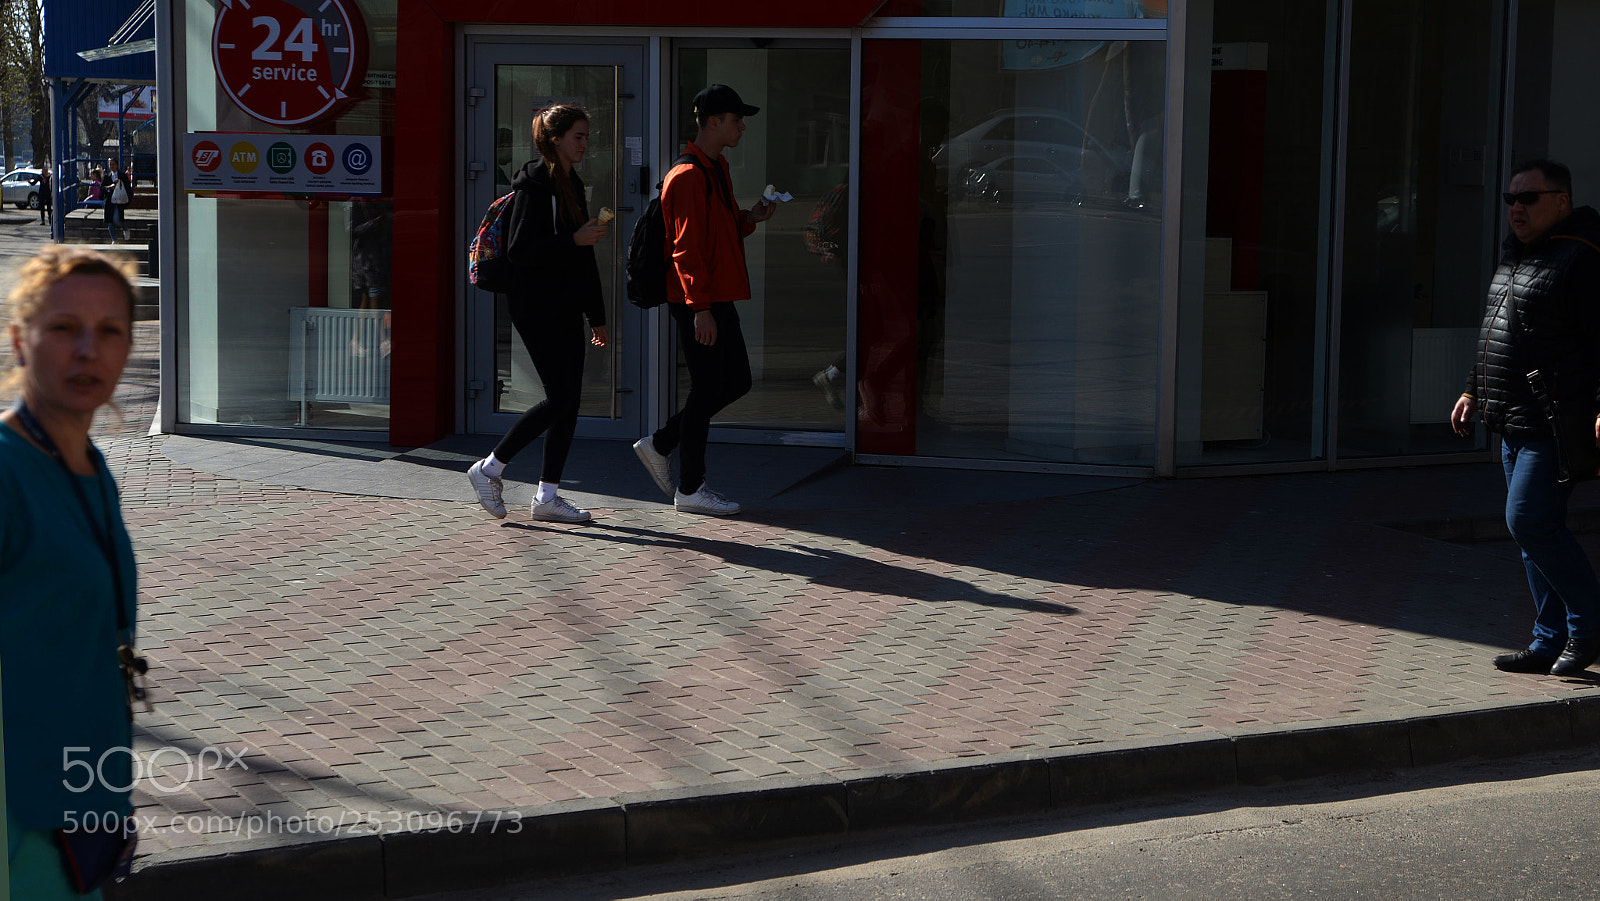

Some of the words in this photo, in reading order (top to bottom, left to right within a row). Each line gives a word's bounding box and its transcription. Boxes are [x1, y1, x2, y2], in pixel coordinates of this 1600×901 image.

[251, 15, 319, 62] 24
[321, 19, 341, 37] hr
[252, 63, 318, 81] service
[232, 152, 257, 163] ATM
